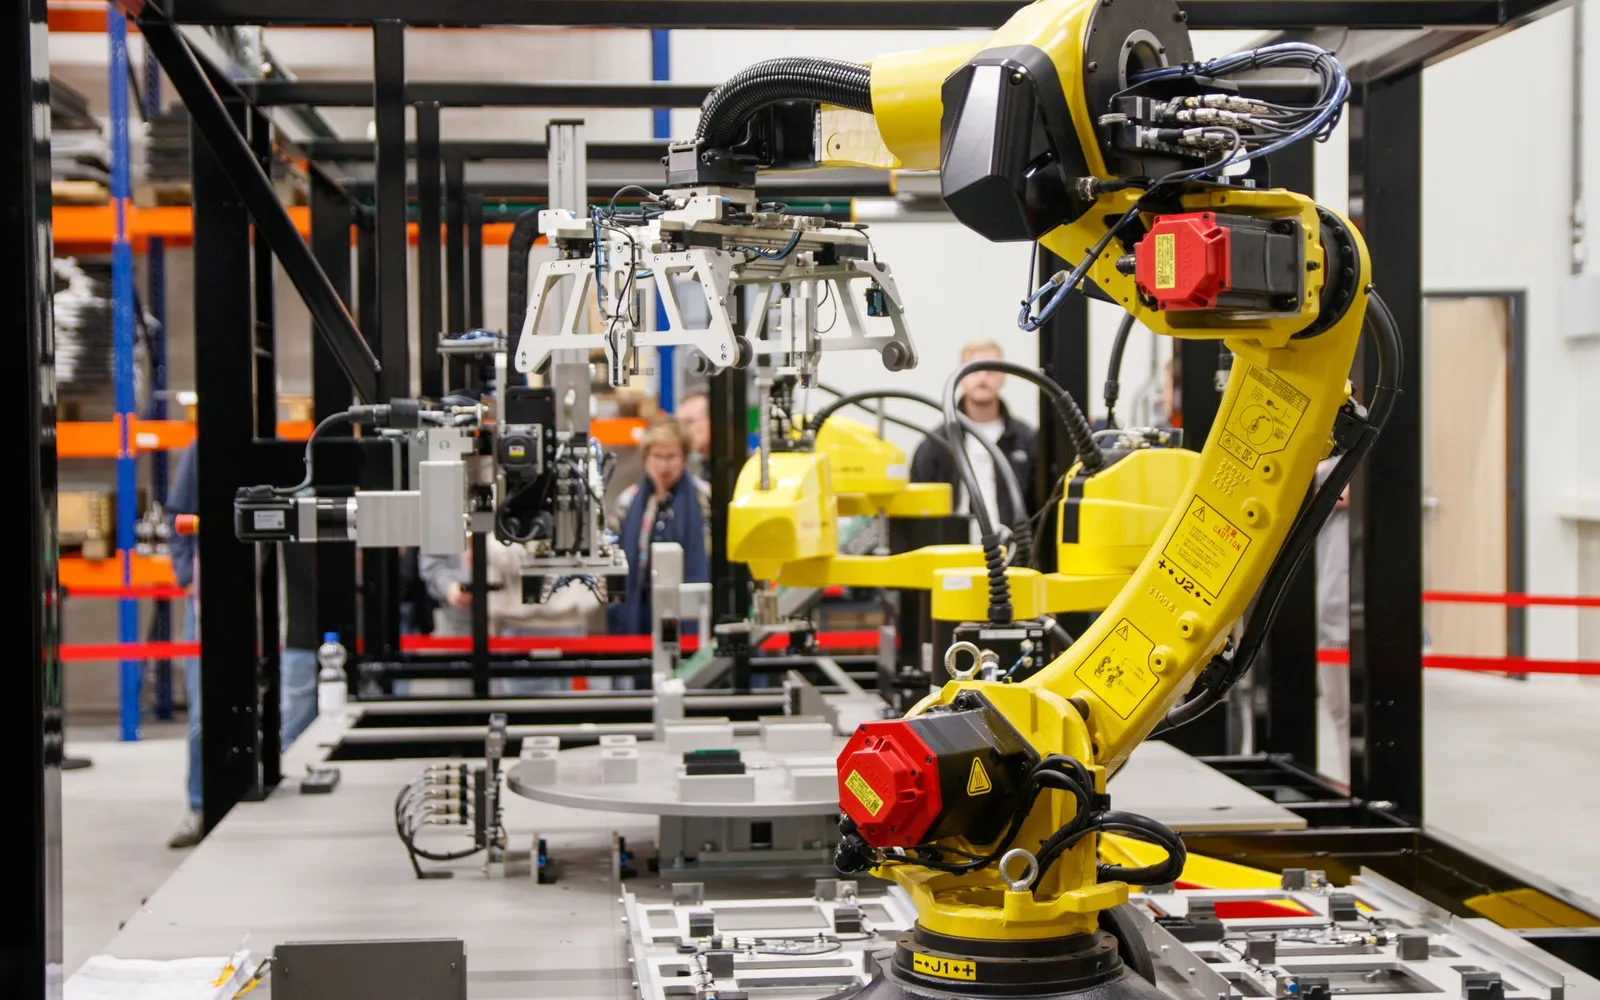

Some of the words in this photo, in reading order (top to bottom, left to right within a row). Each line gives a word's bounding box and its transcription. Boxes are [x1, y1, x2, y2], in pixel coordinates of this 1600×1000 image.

[1179, 228, 1192, 289] FANUC
[1212, 525, 1242, 552] CAUTION
[1175, 577, 1195, 594] J2
[931, 961, 948, 975] J1
